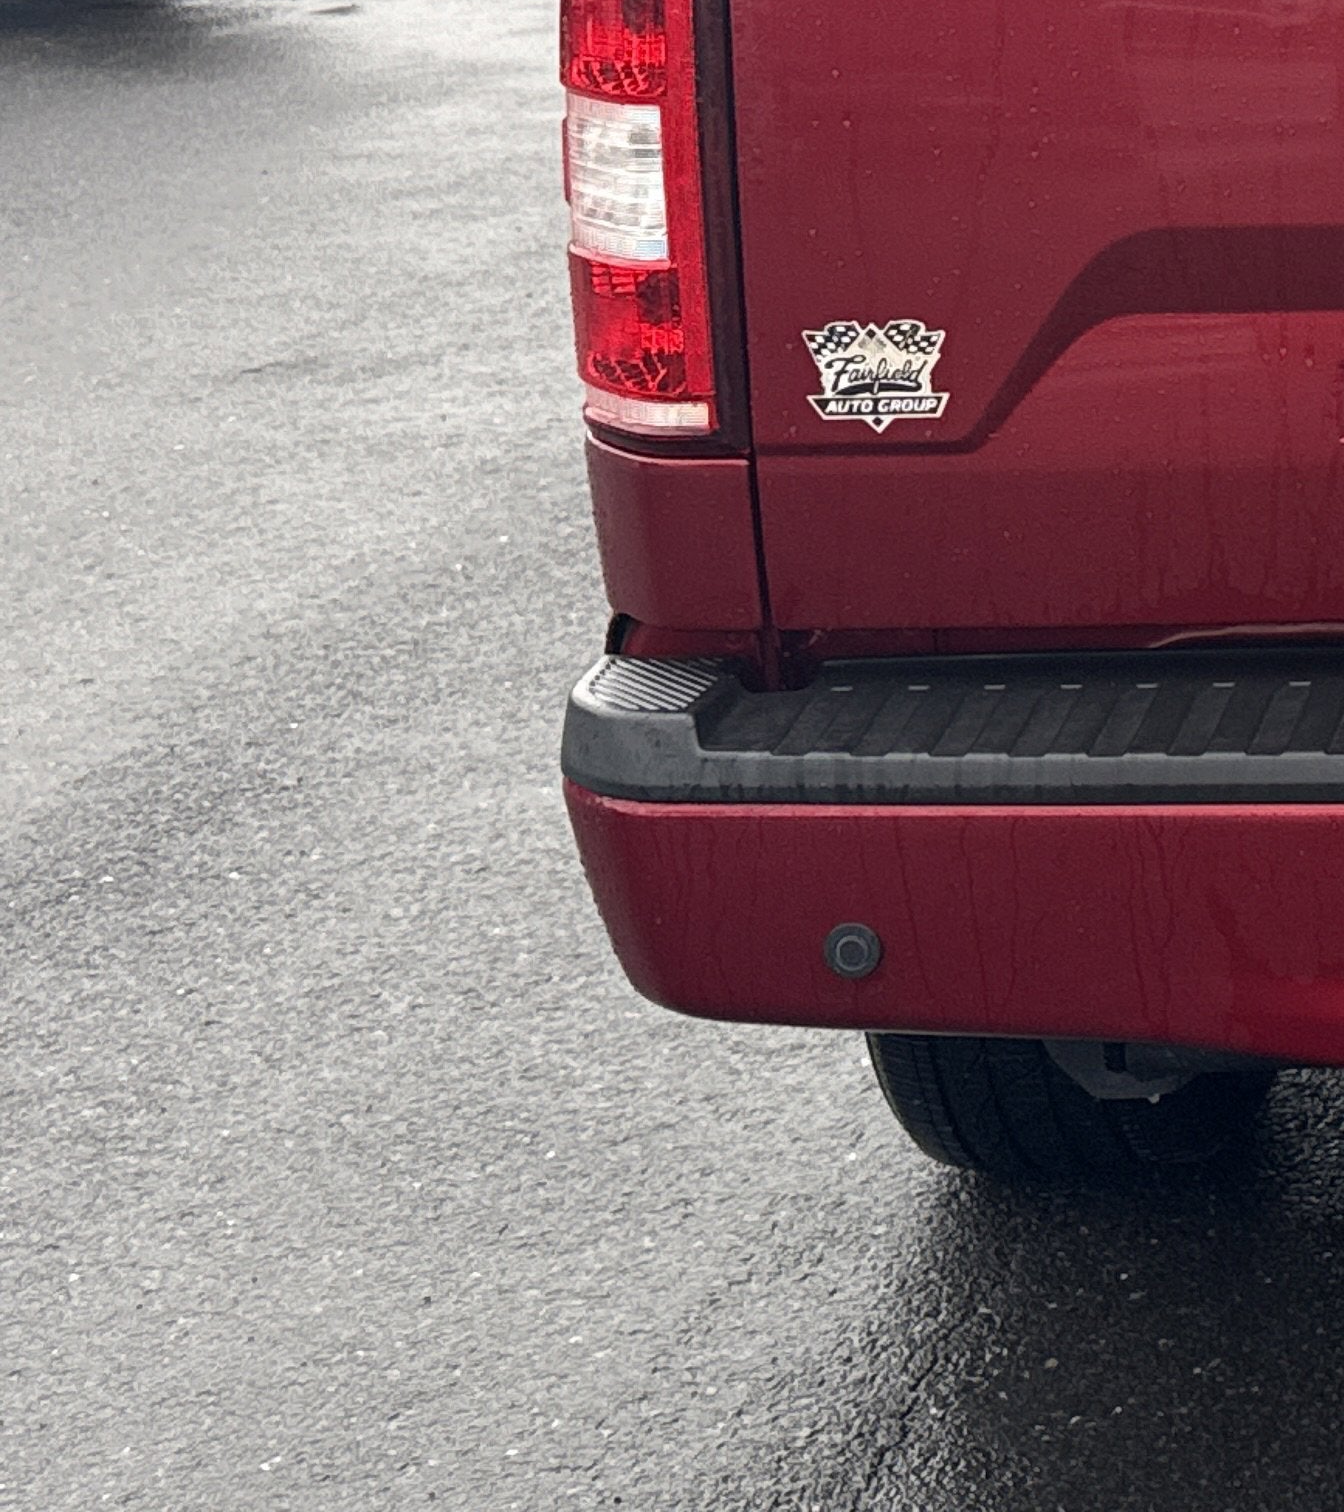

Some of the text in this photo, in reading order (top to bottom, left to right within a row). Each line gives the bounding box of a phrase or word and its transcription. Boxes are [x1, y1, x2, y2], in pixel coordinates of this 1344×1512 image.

[824, 354, 929, 395] Fairfield
[825, 397, 938, 414] AUTO GROUP
